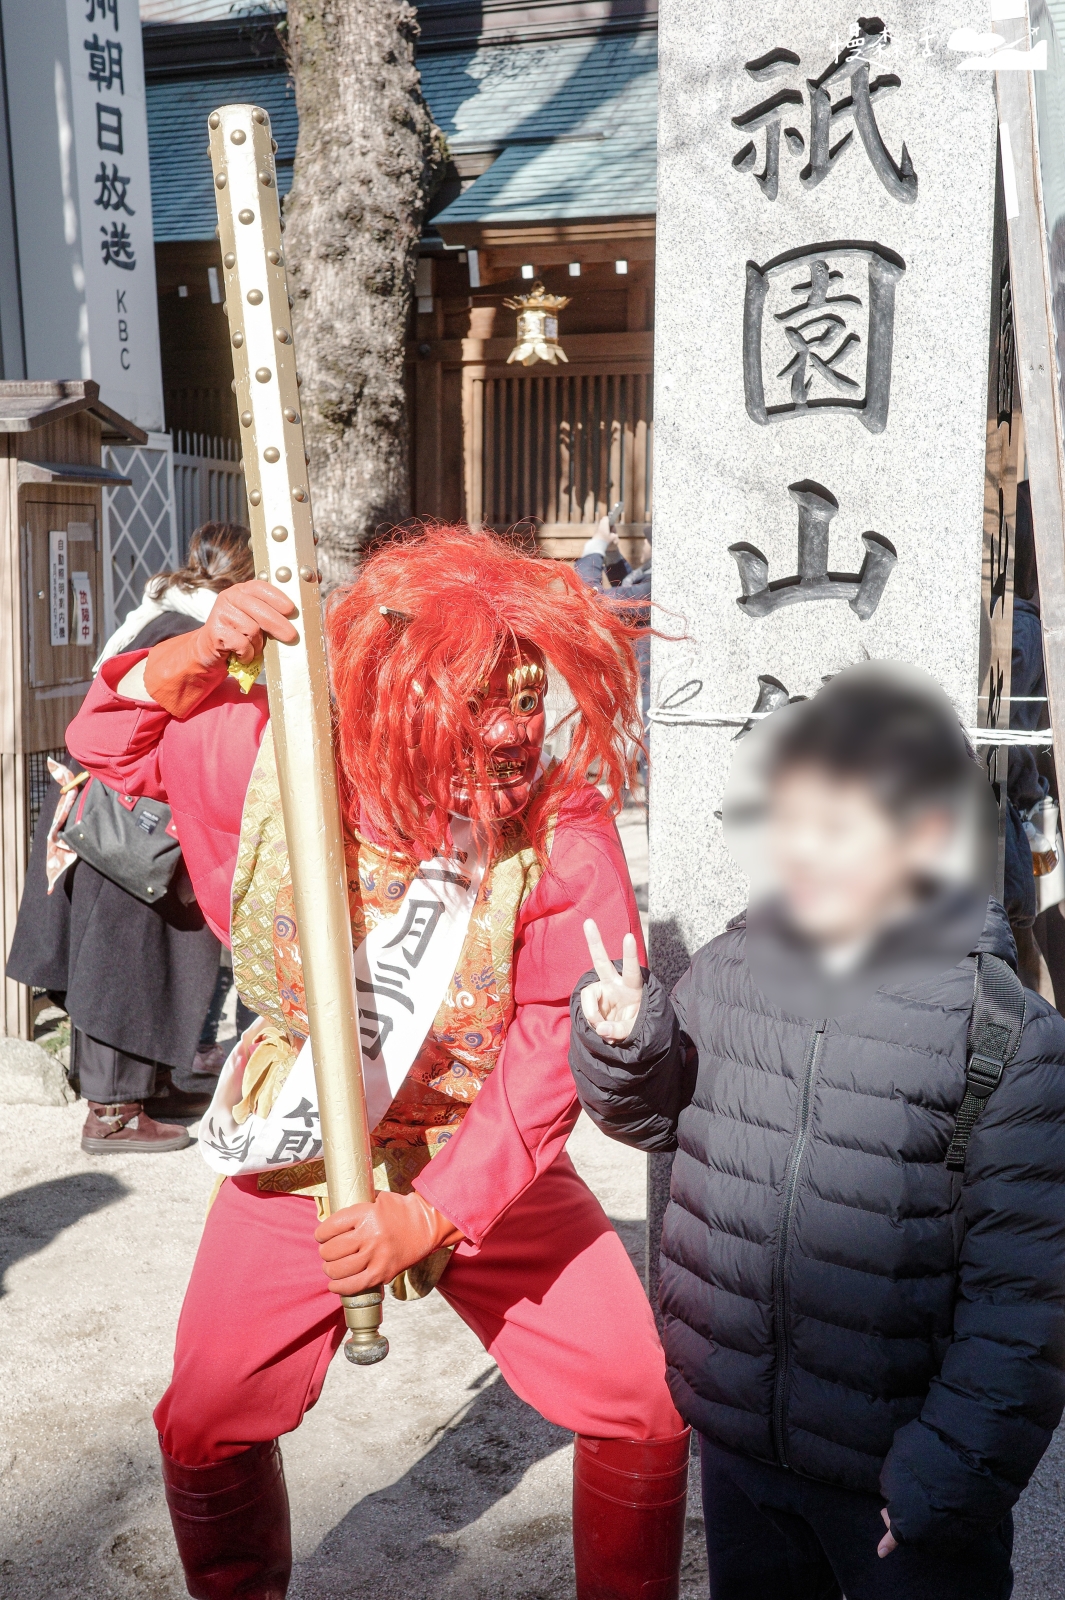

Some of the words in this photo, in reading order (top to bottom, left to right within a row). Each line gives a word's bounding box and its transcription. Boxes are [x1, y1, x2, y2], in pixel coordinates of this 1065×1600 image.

[116, 289, 131, 371] KBC
[728, 17, 918, 738] 祇園山
[79, 590, 90, 640] 故障中
